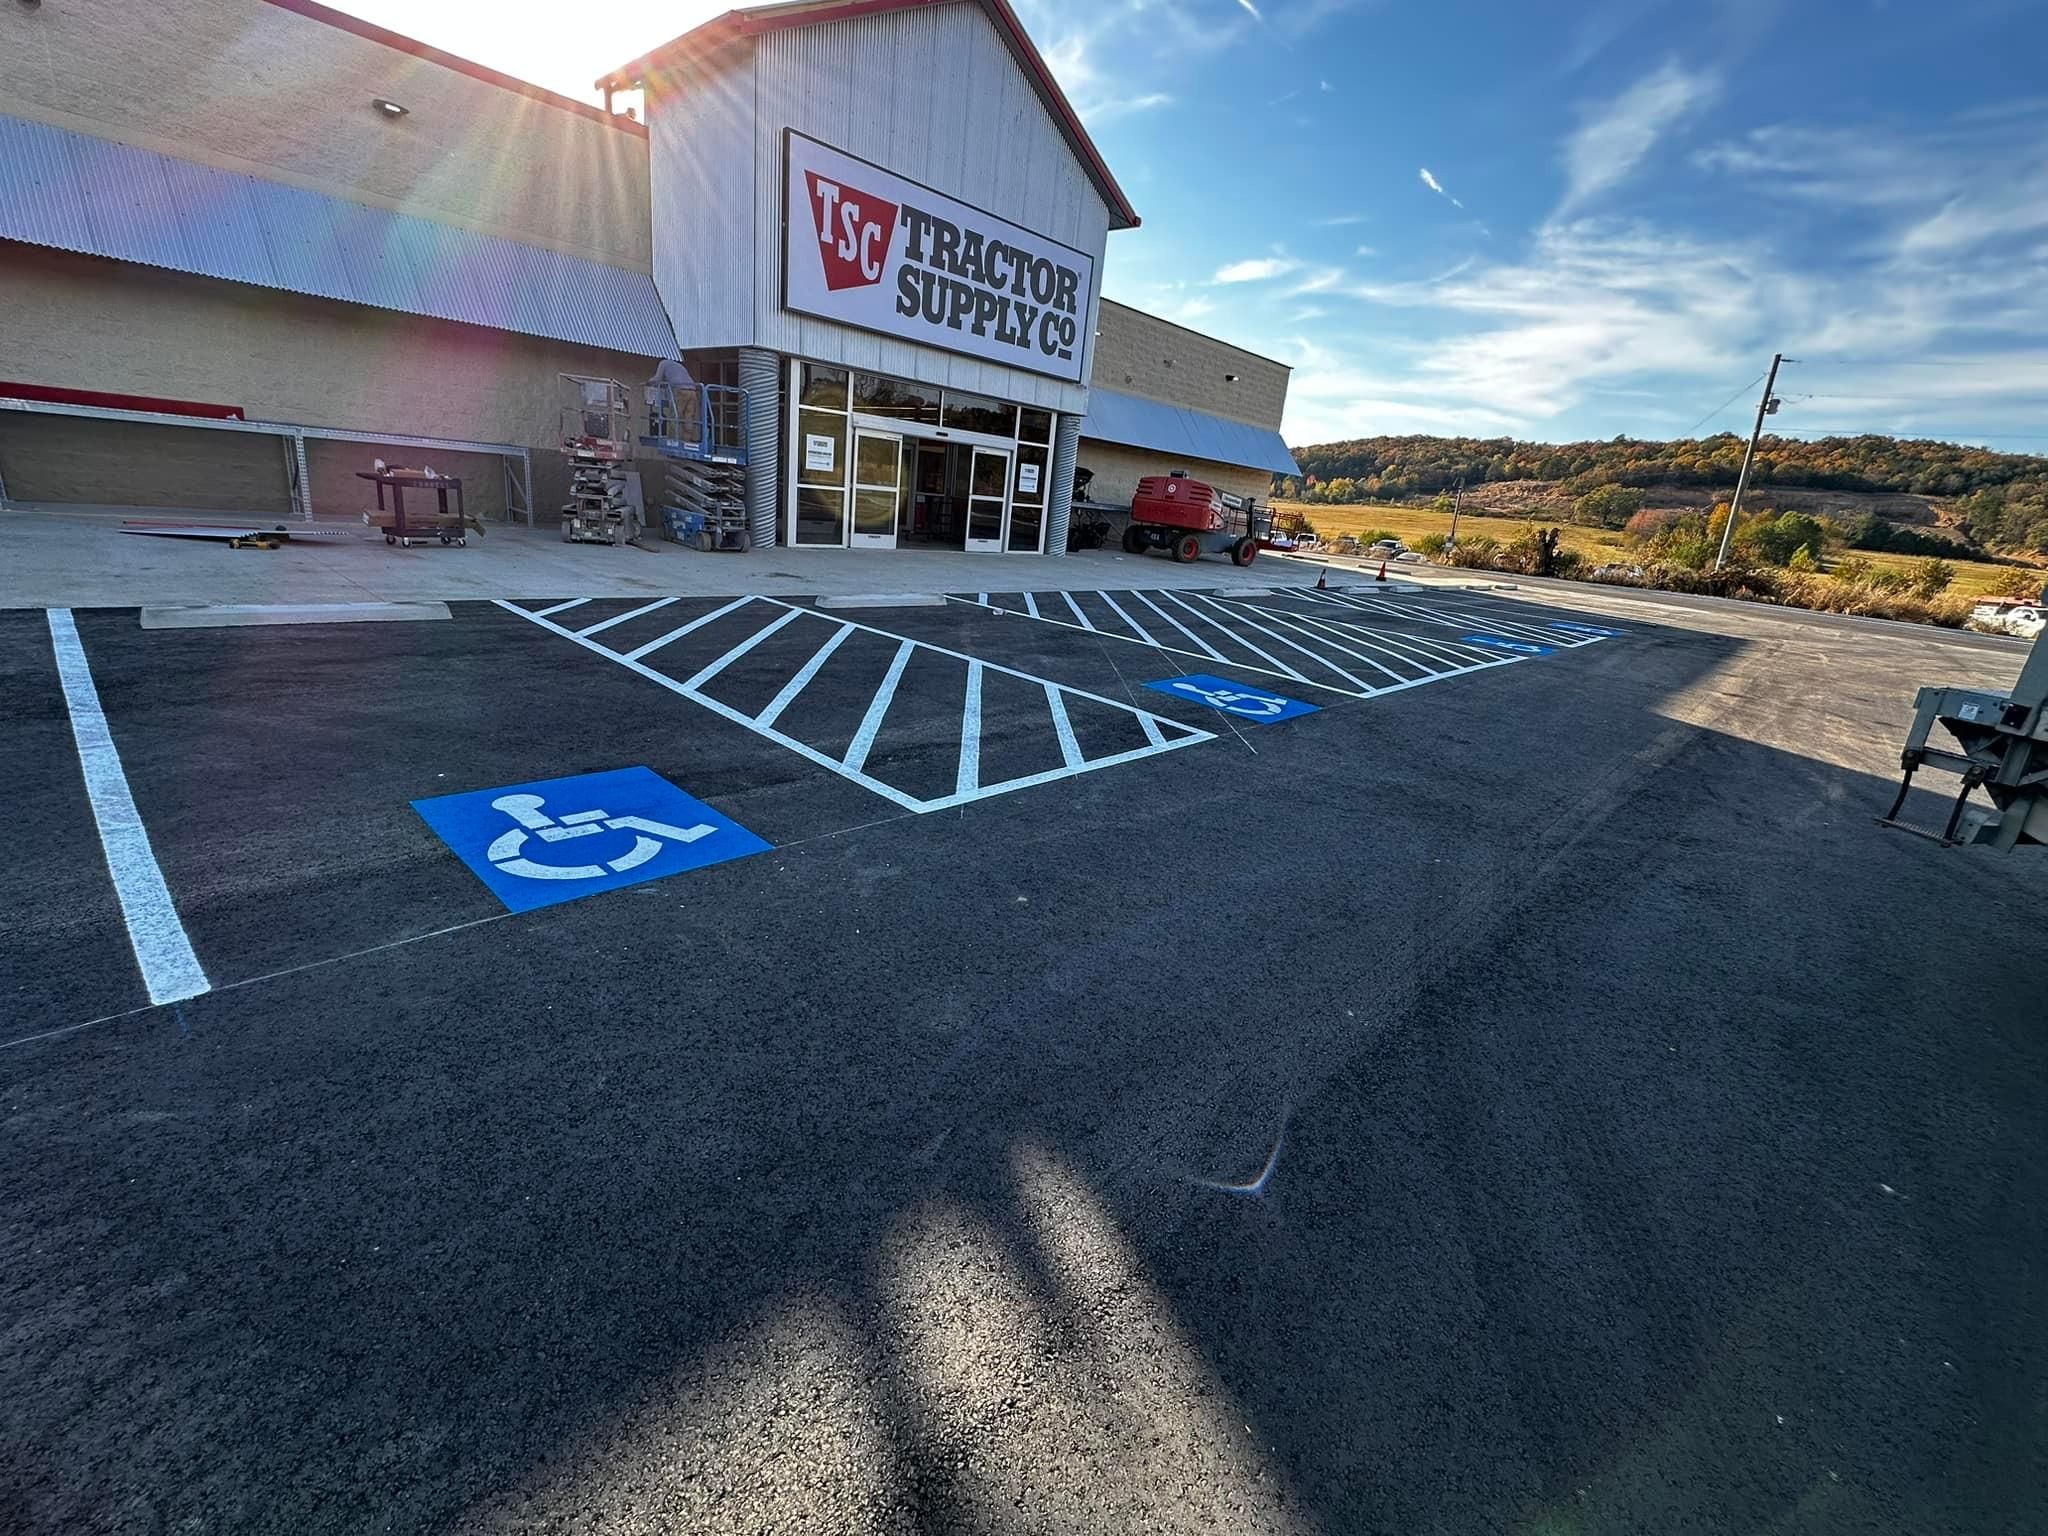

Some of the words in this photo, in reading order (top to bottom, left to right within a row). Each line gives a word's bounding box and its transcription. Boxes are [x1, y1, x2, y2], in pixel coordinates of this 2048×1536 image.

[816, 179, 881, 280] TSC
[901, 203, 1078, 314] TRACTOR
[896, 264, 1037, 349] SUPPLY
